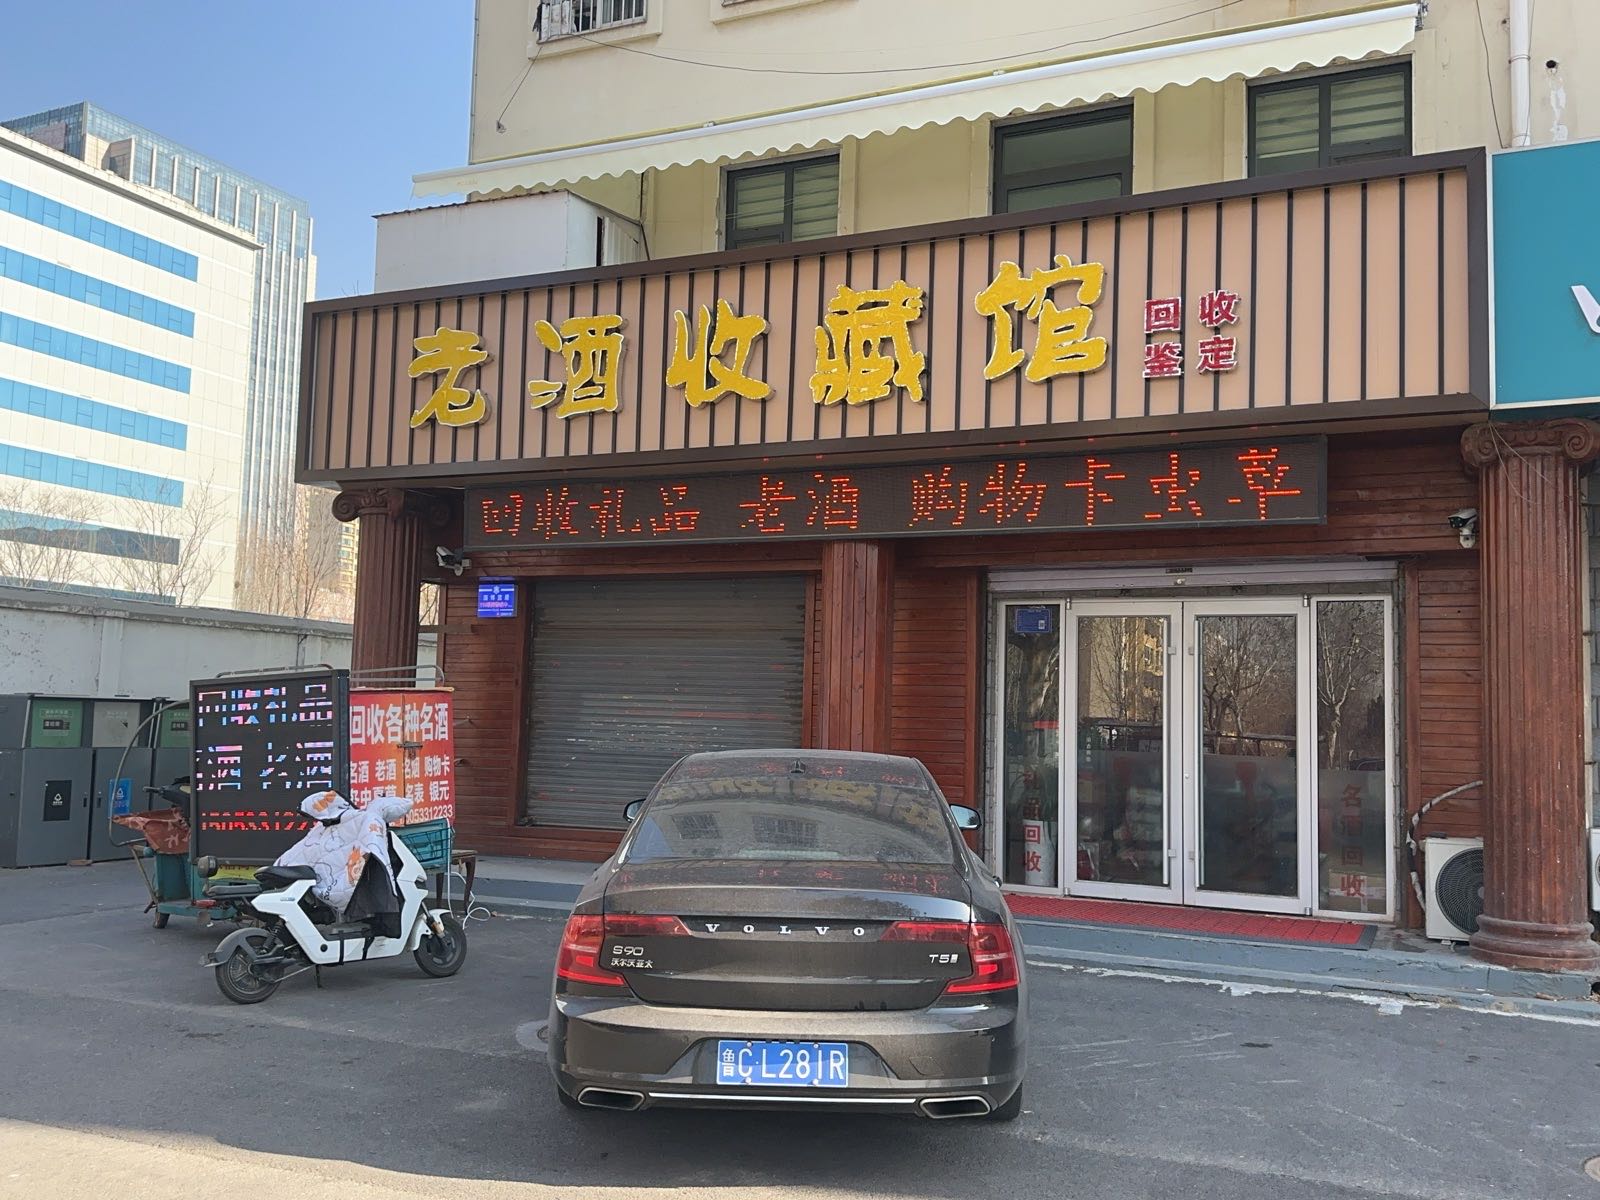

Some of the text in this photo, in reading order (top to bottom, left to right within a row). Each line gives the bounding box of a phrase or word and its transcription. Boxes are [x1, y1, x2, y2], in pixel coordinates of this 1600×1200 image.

[1143, 290, 1239, 333] 回收
[407, 253, 1109, 430] 老酒收藏馆
[1142, 335, 1238, 378] 鉴定
[349, 702, 449, 746] 回收各种名酒
[375, 758, 397, 782] 老酒
[612, 945, 644, 956] S90
[705, 923, 865, 936] VOLVO
